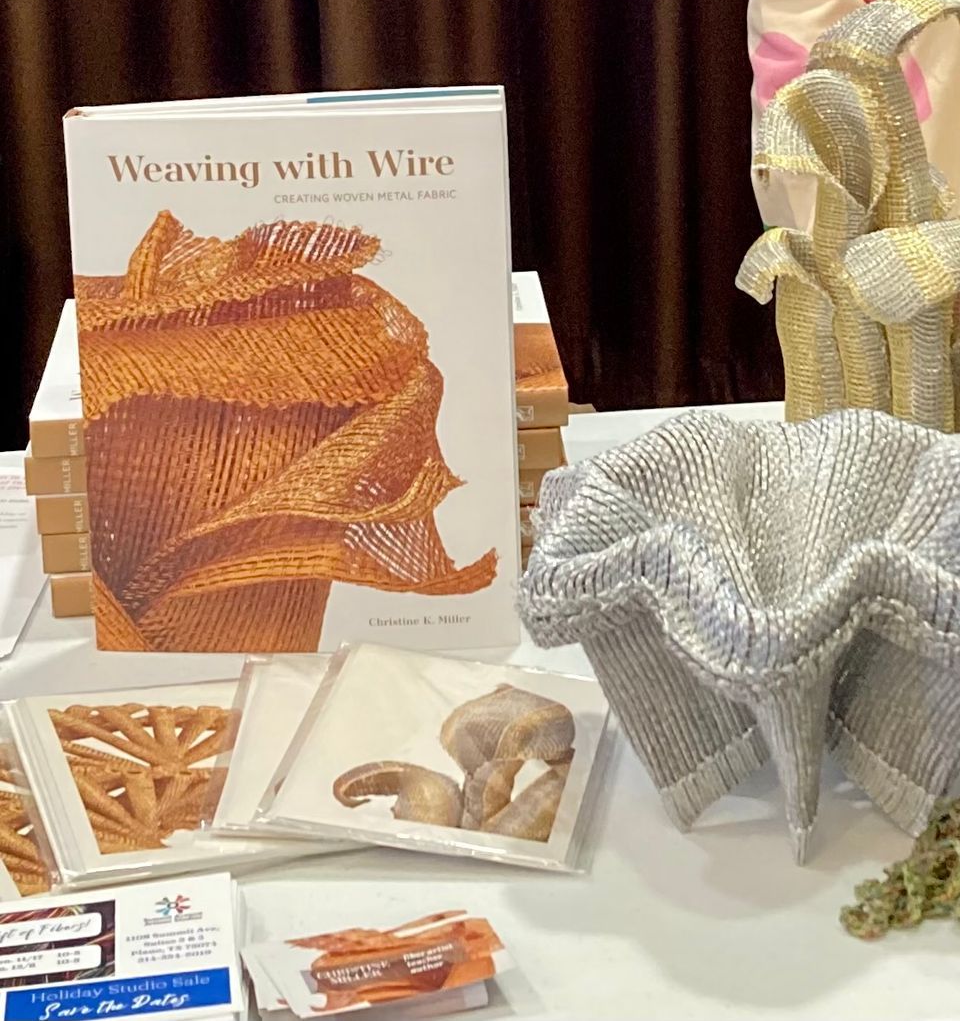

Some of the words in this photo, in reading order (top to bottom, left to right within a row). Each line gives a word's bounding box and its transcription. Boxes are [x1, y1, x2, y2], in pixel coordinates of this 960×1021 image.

[107, 154, 260, 189] Weaving
[273, 152, 354, 180] with
[366, 149, 455, 178] Wire
[274, 193, 329, 204] CREATING
[333, 192, 374, 203] WOVEN
[378, 191, 414, 201] METAL
[417, 189, 456, 200] FABRIC
[68, 422, 78, 456] MILLER
[62, 459, 72, 493] MILLER
[368, 617, 419, 627] Christine
[423, 616, 435, 625] K.
[438, 614, 471, 624] Miller
[403, 952, 425, 962] fiber
[426, 943, 453, 955] artist
[31, 986, 103, 1003] Holiday
[108, 981, 167, 995] Studio
[172, 975, 210, 989] Sale
[39, 1002, 93, 1021] Save
[96, 998, 128, 1014] the
[131, 993, 190, 1012] Dates
